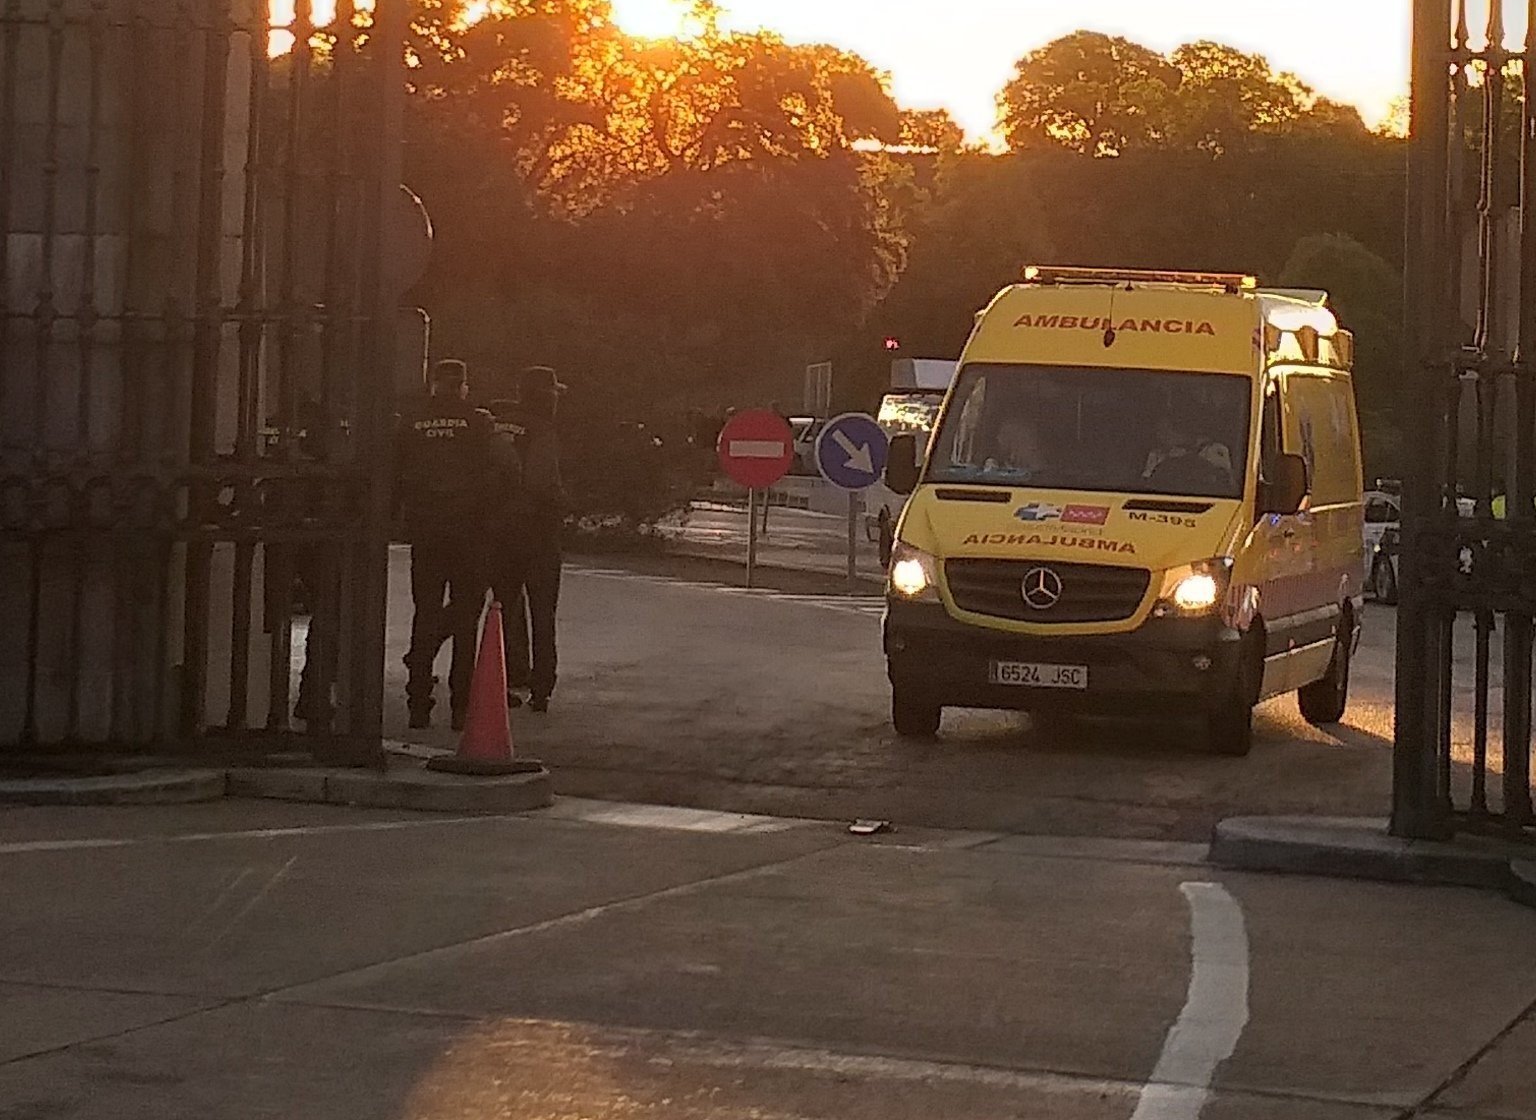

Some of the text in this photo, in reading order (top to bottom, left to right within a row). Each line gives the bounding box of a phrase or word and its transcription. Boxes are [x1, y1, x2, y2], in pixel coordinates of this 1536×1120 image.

[1013, 314, 1216, 336] AMBULANCIA
[414, 418, 469, 430] GUARDIA
[425, 429, 454, 438] CIVIL
[1001, 665, 1040, 683] 6524
